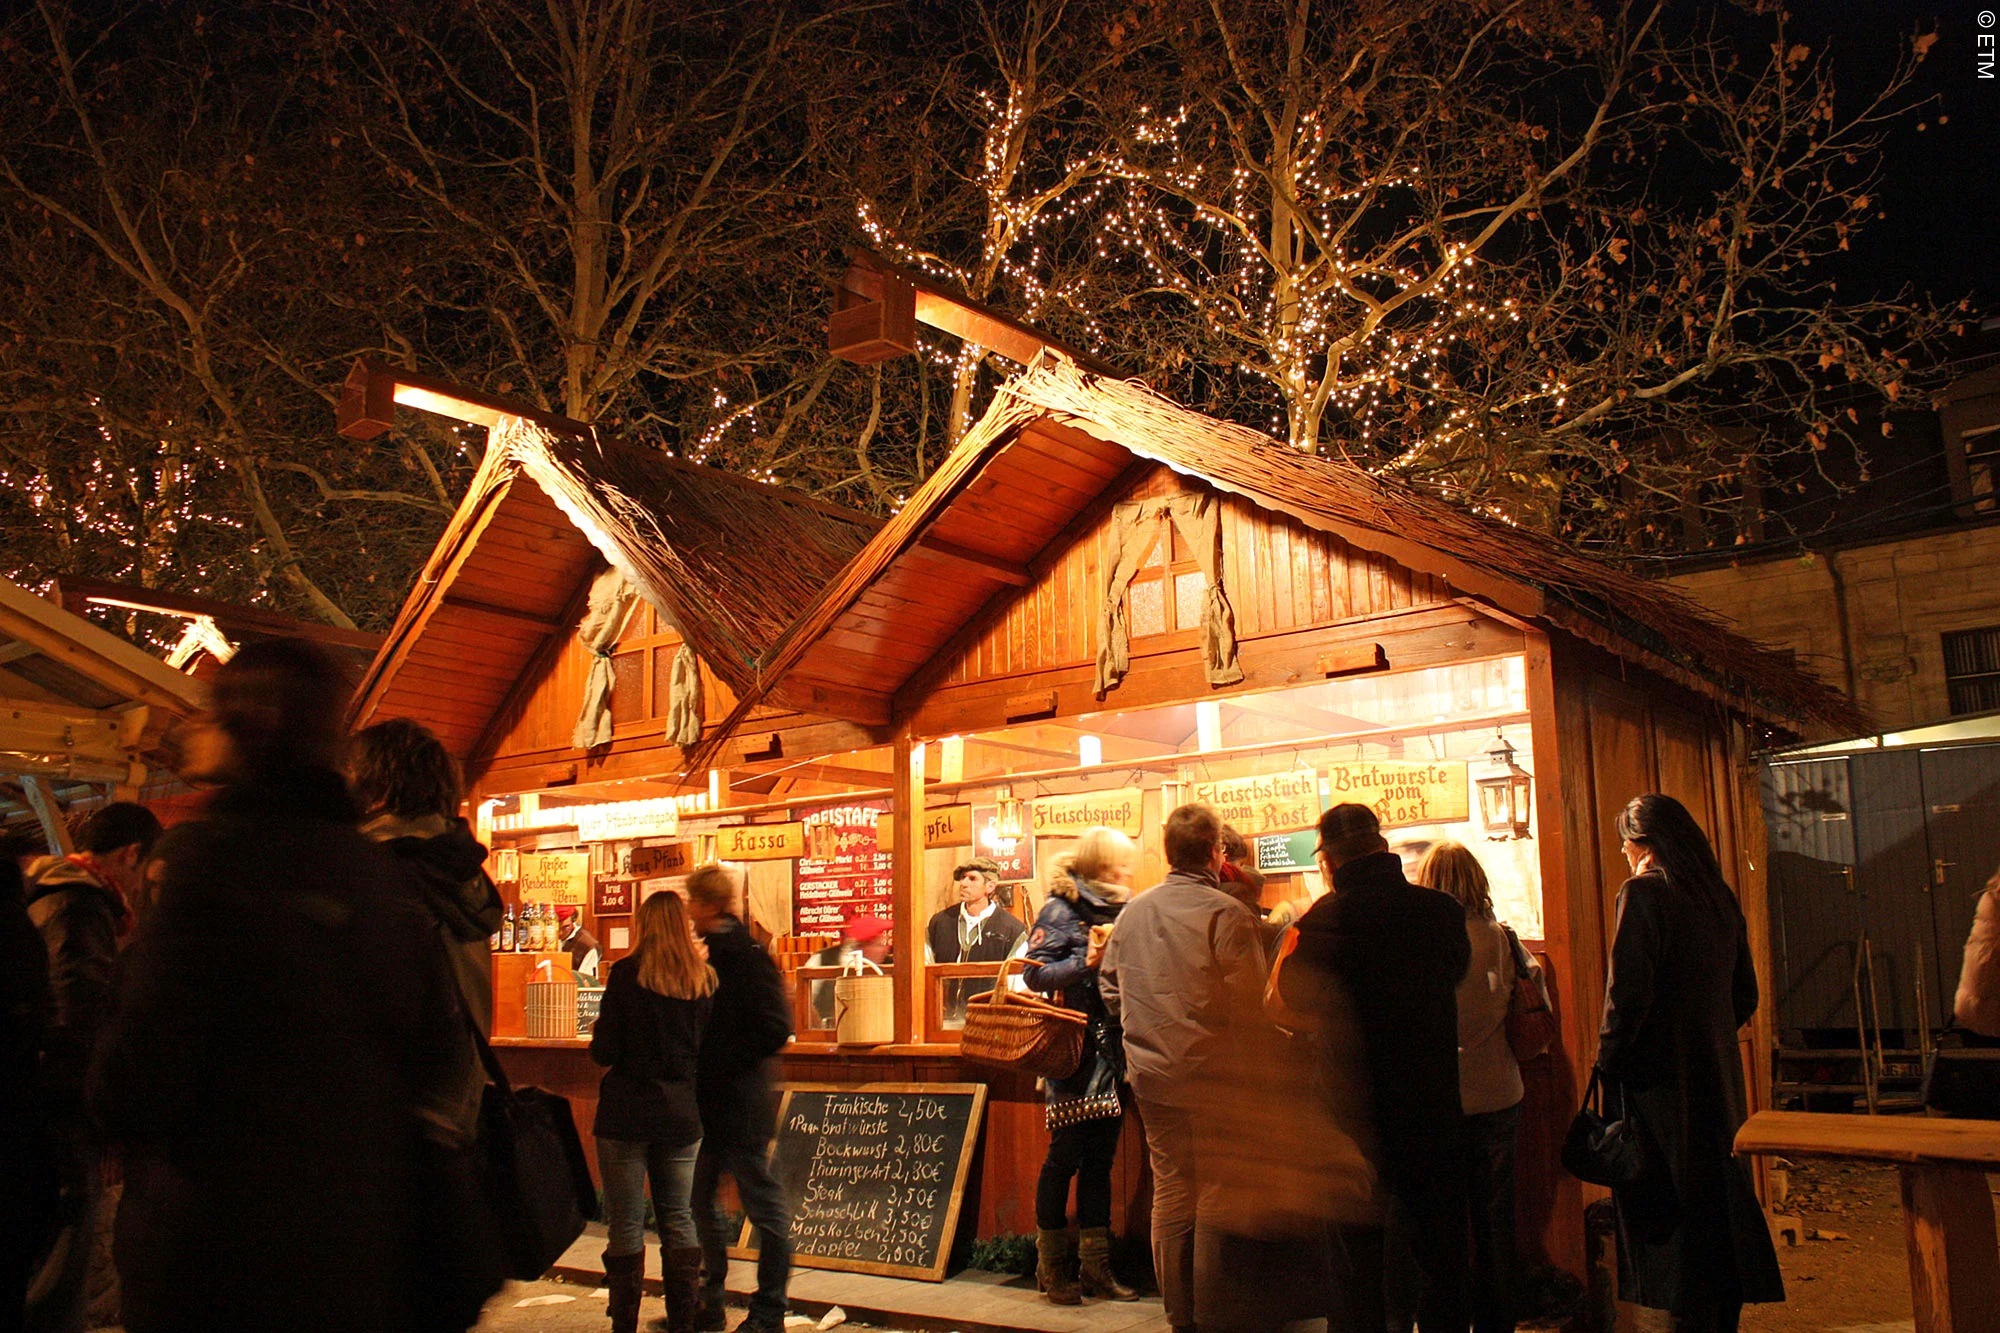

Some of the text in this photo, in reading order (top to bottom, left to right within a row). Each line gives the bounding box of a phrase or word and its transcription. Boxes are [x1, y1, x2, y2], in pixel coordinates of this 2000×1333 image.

[1332, 765, 1448, 792] Bratwürste
[1384, 783, 1422, 800] vom
[801, 807, 878, 838] PREISTAFE
[1034, 801, 1132, 829] Fleischspieß
[1220, 802, 1309, 831] vom Rost
[1374, 798, 1429, 824] Rost
[924, 815, 954, 839] pfel
[731, 830, 785, 852] Kassa
[539, 857, 568, 876] Heißer
[621, 849, 685, 876] Krug Pfand
[1011, 859, 1021, 870] €
[551, 889, 578, 903] Wein
[617, 896, 625, 905] €
[822, 1117, 889, 1135] Bratwürste
[816, 1136, 888, 1159] Bockwurst
[804, 1178, 844, 1202] Steak
[790, 1237, 862, 1258] rdapfel
